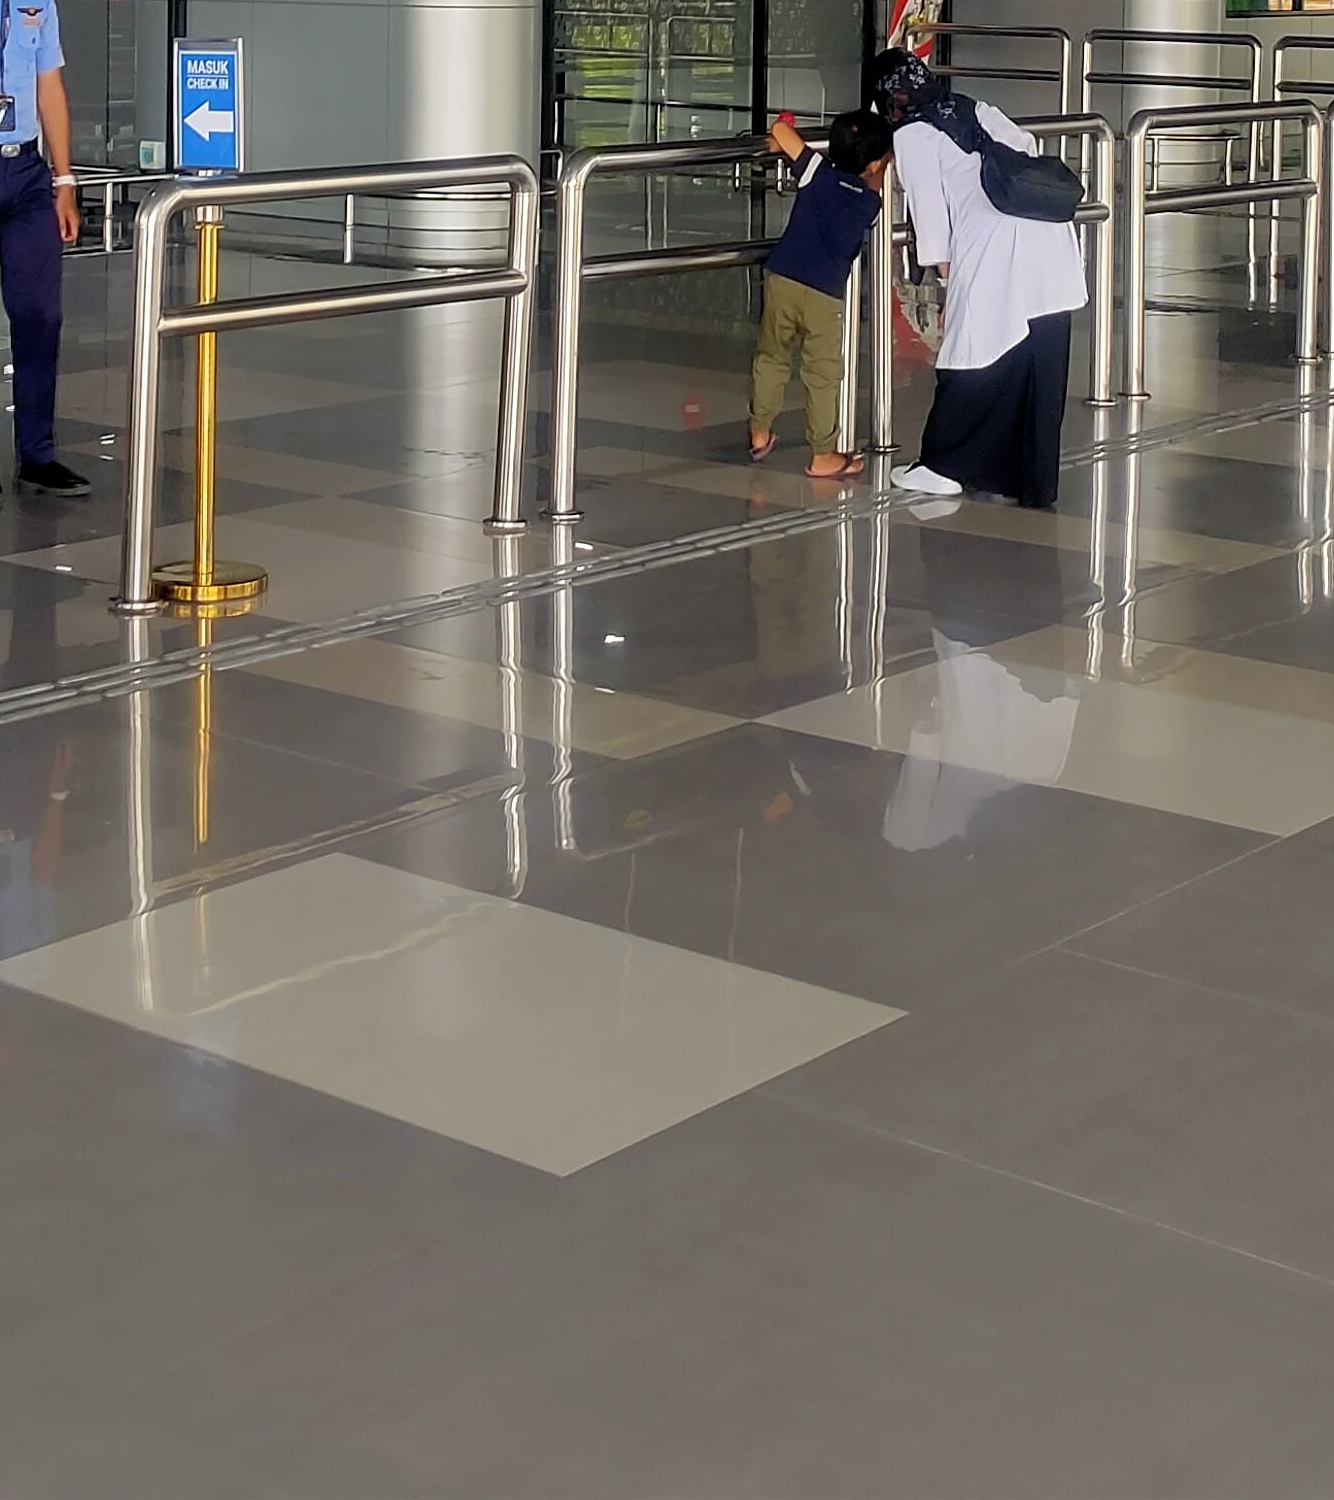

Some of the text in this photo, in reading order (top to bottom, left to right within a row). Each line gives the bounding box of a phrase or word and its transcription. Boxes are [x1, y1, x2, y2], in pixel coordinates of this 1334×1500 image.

[187, 59, 229, 74] MASUK
[187, 77, 229, 90] CHECK IN
